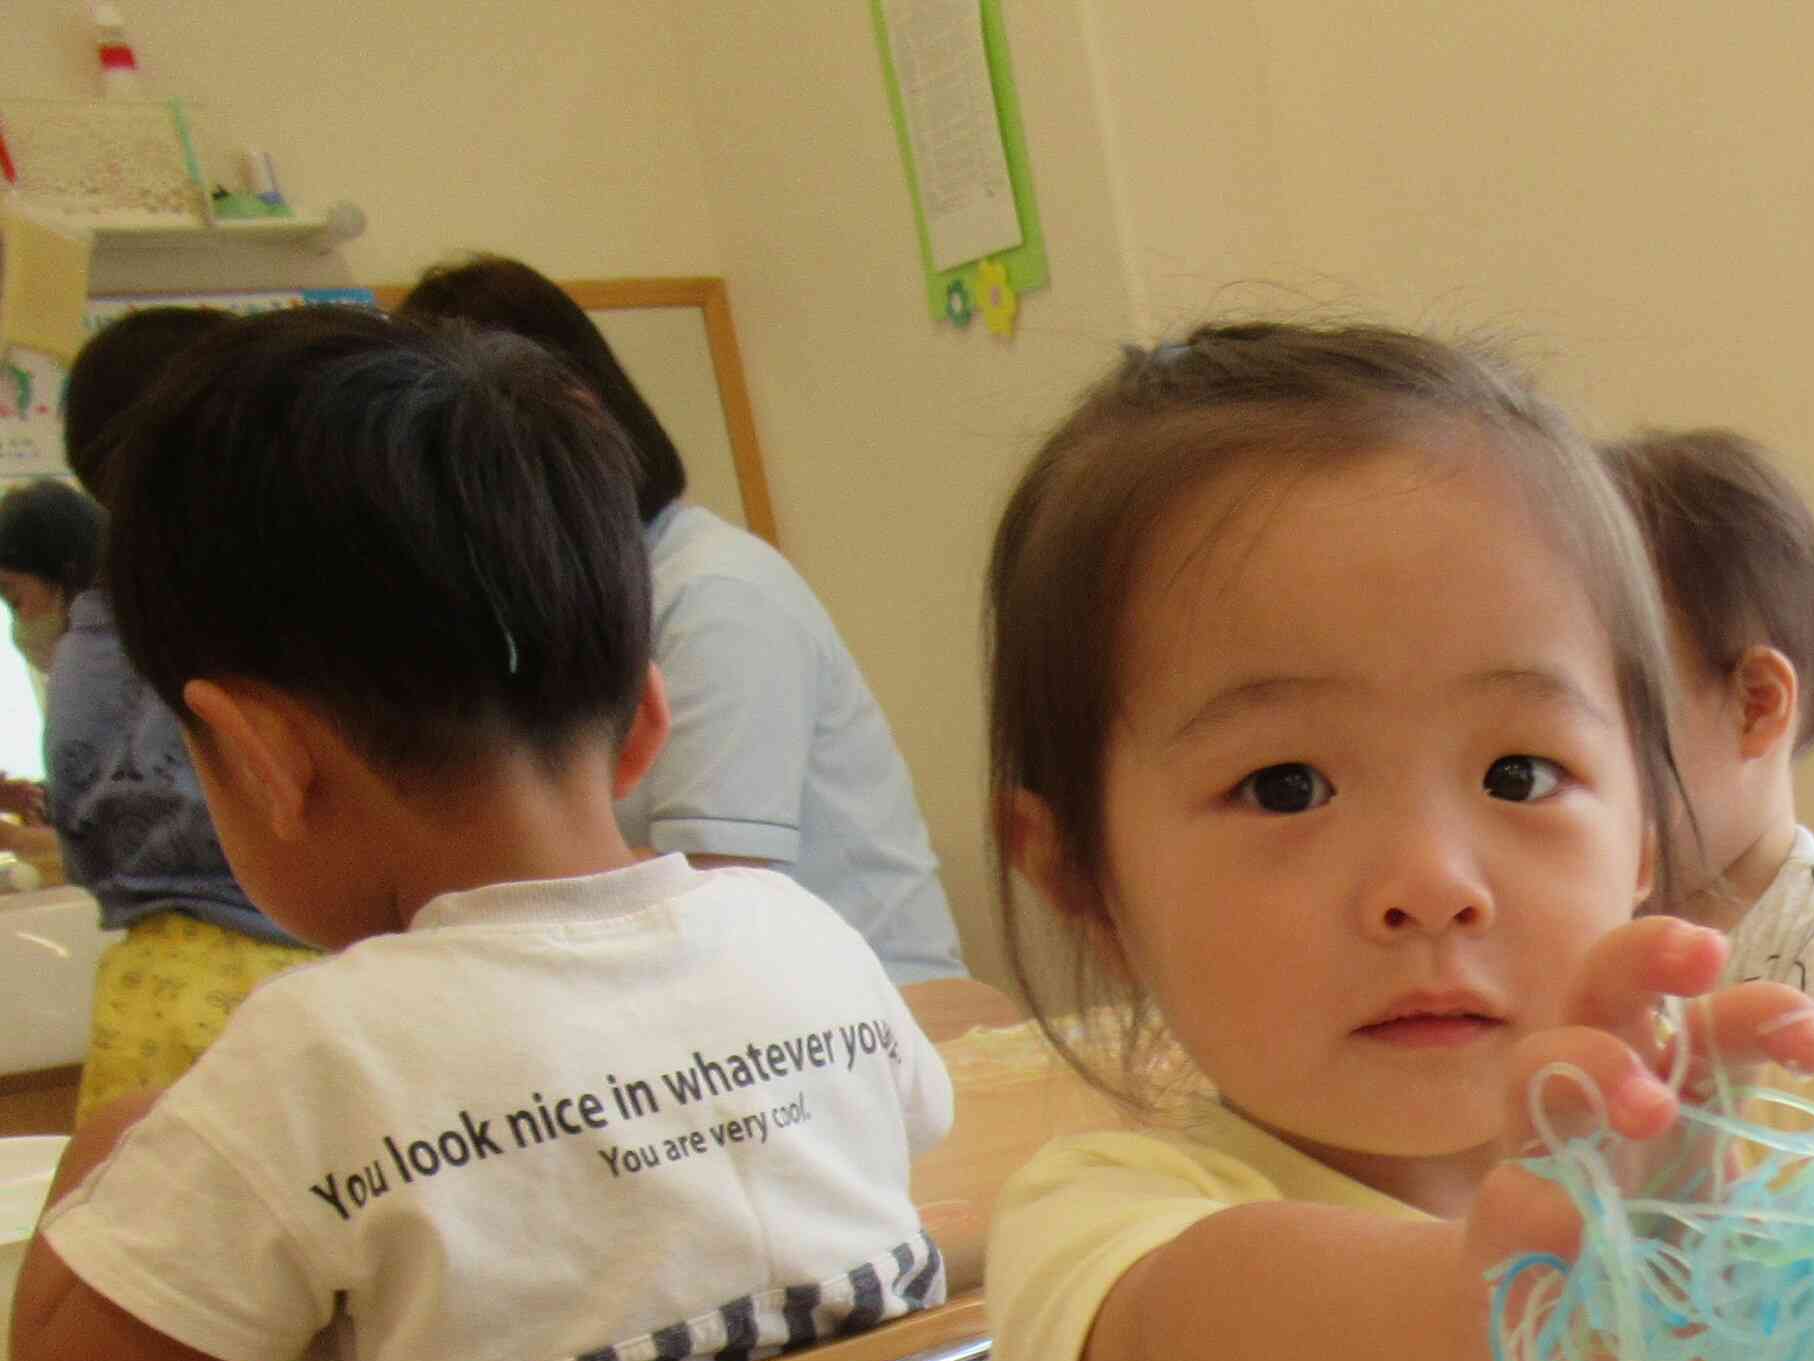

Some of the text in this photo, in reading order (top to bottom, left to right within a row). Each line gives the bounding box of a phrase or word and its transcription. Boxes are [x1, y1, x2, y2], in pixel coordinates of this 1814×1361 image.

[308, 1160, 391, 1222] You
[383, 1110, 504, 1185] look
[505, 1083, 609, 1149] nice
[606, 1073, 660, 1121] in
[660, 1029, 836, 1107] whatever
[597, 1144, 661, 1179] You
[662, 1130, 708, 1163] are
[708, 1110, 770, 1150] very
